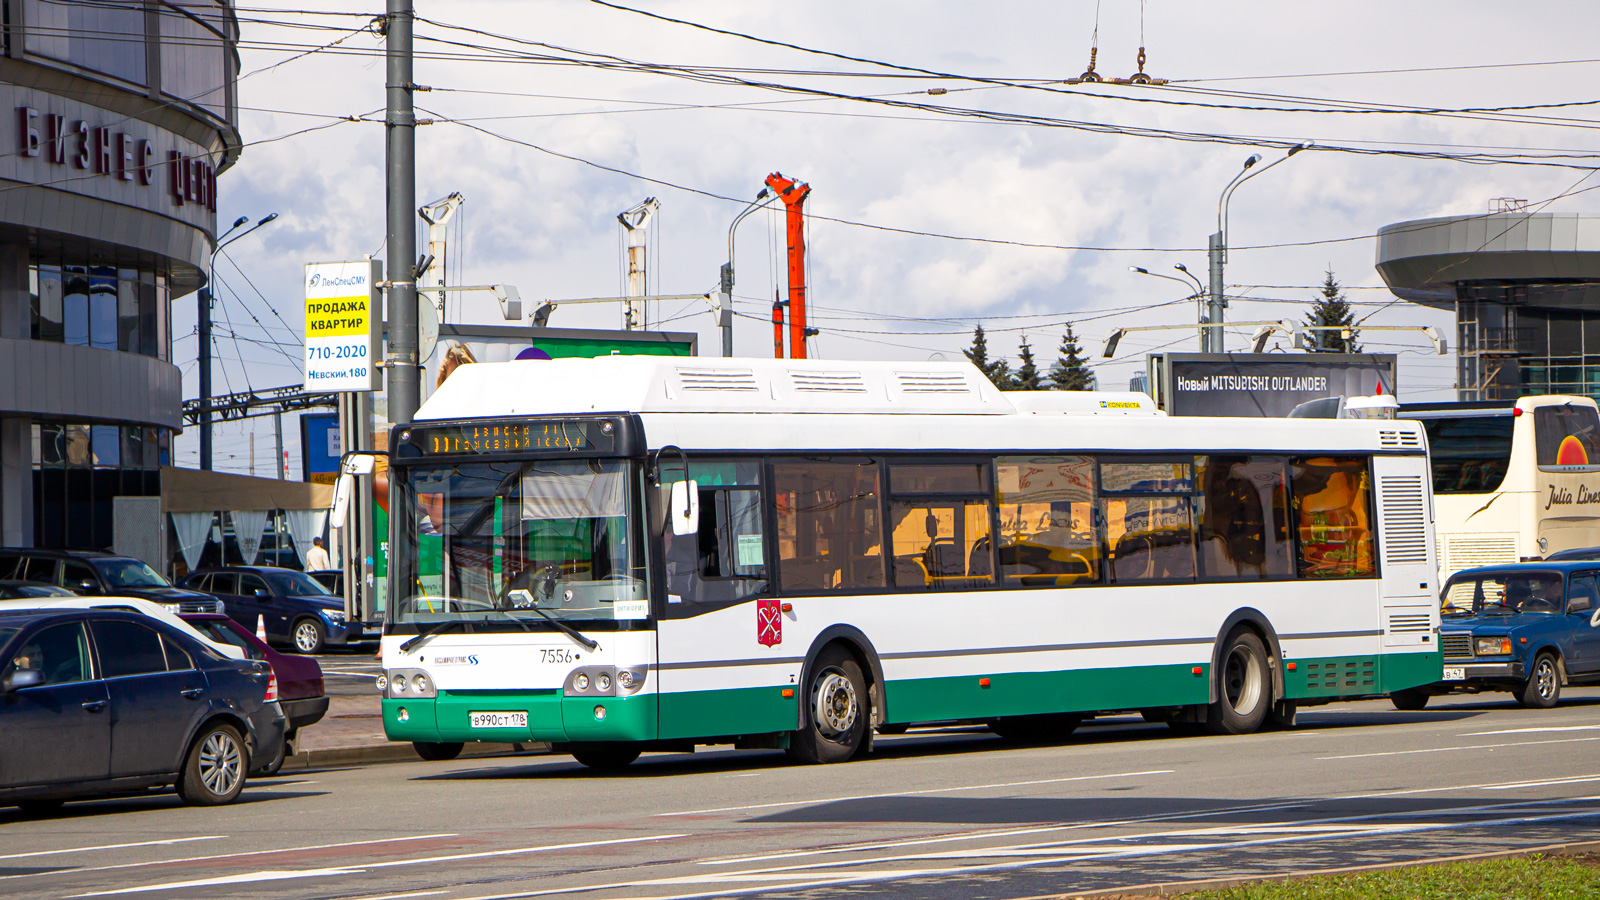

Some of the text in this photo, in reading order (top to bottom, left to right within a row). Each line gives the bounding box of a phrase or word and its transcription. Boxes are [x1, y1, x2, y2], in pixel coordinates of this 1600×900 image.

[20, 107, 153, 186] БИЗНЕС
[322, 276, 366, 287] ЛенСпецСМУ
[308, 301, 366, 314] ПРОДАЖА
[311, 318, 363, 330] КВАРТИР
[308, 345, 367, 360] 710-2020
[1177, 375, 1327, 391] Новый MITSUBISHI OUTLANDER
[1545, 484, 1572, 510] Julia
[540, 649, 572, 663] 7556
[474, 715, 509, 726] В990СТ
[511, 714, 524, 722] 178
